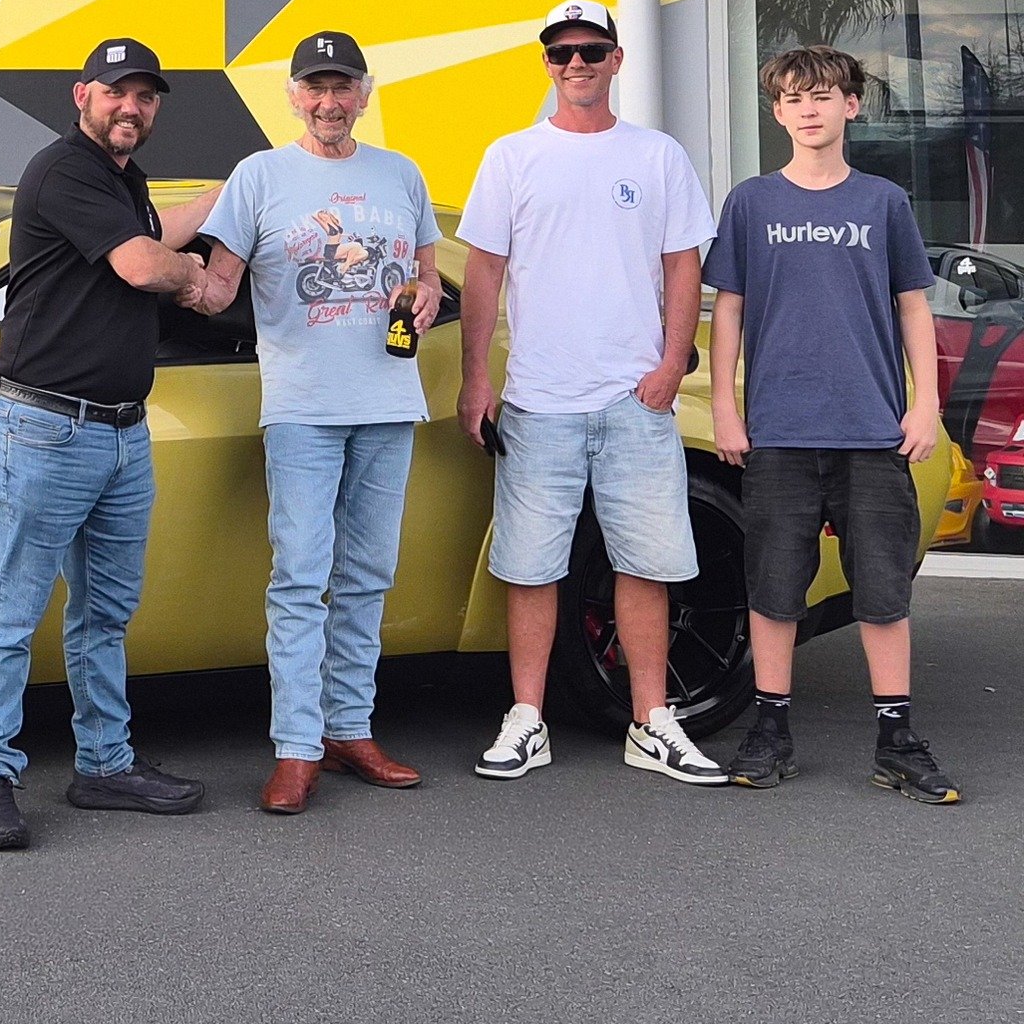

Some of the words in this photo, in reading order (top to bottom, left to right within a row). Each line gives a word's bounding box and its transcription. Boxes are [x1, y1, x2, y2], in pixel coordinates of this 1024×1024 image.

[766, 221, 846, 245] Hurley
[307, 297, 353, 328] Great
[390, 319, 407, 335] 4
